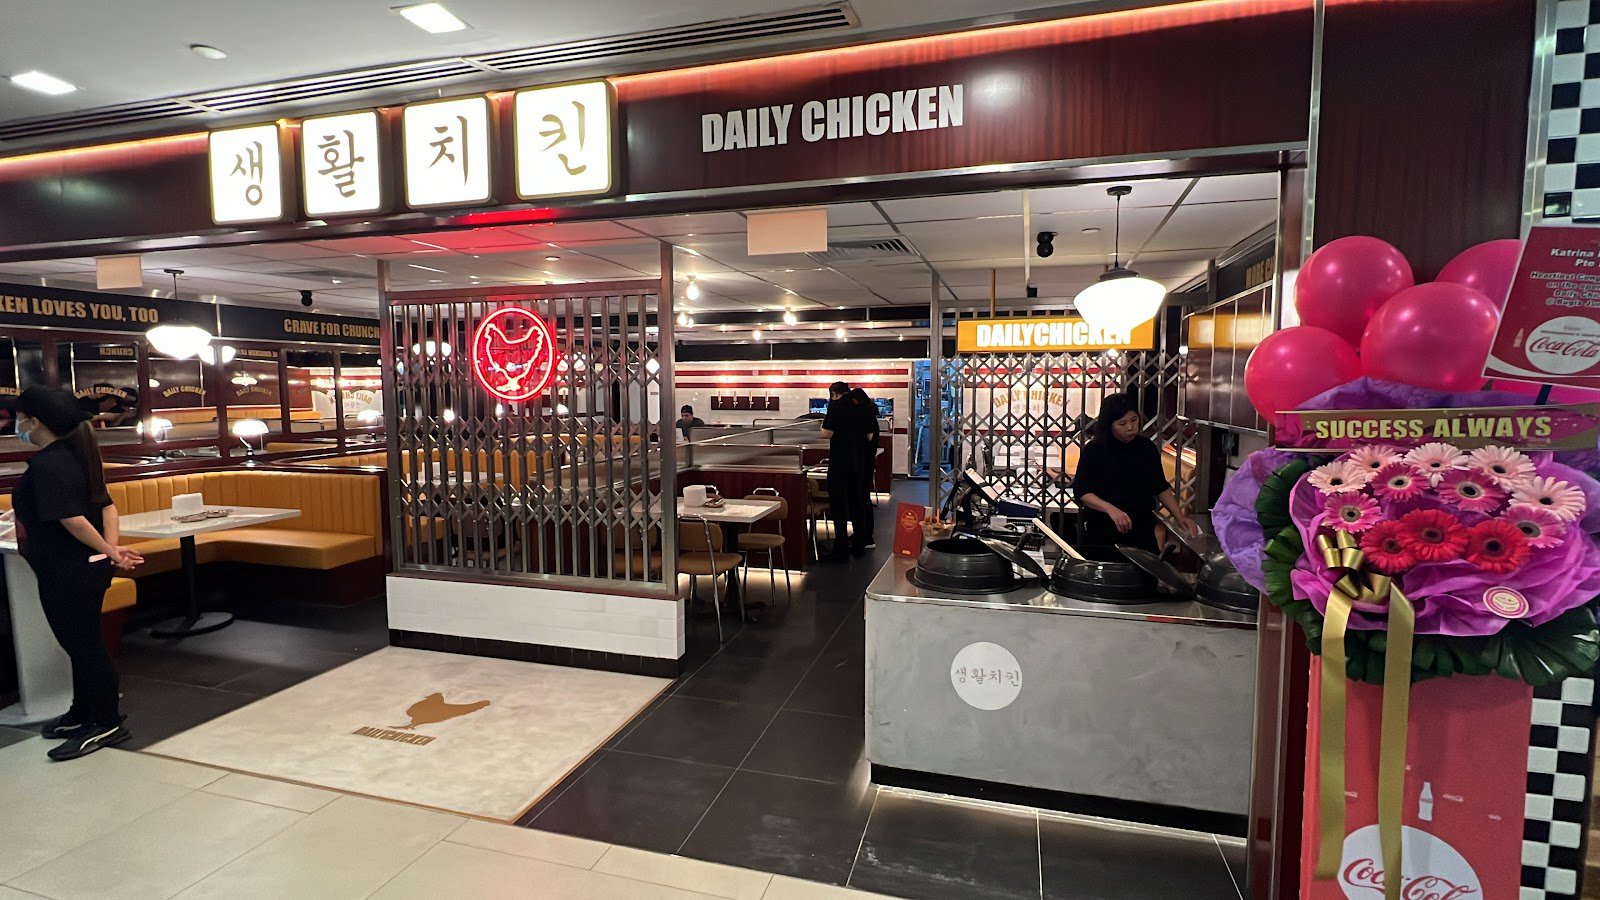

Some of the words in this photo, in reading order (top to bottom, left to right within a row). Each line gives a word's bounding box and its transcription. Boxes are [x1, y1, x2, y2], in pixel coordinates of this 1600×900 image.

[702, 104, 793, 153] DAILY
[801, 84, 963, 143] CHICKEN
[1551, 248, 1594, 257] Katrina
[1575, 258, 1595, 267] Pte
[1530, 271, 1575, 280] Heartiest
[1554, 289, 1579, 298] Daily
[1561, 281, 1577, 289] the
[32, 297, 87, 318] LOVES
[89, 303, 126, 322] YOU,
[128, 306, 159, 323] TOO
[283, 319, 319, 335] CRAVE
[320, 322, 340, 336] FOR
[976, 322, 1131, 348] DAILYCHICKEN
[993, 391, 1021, 408] DALY
[1316, 419, 1425, 440] SUCCESS
[1432, 416, 1552, 438] ALWAYS
[955, 666, 1020, 687] 생활치킨
